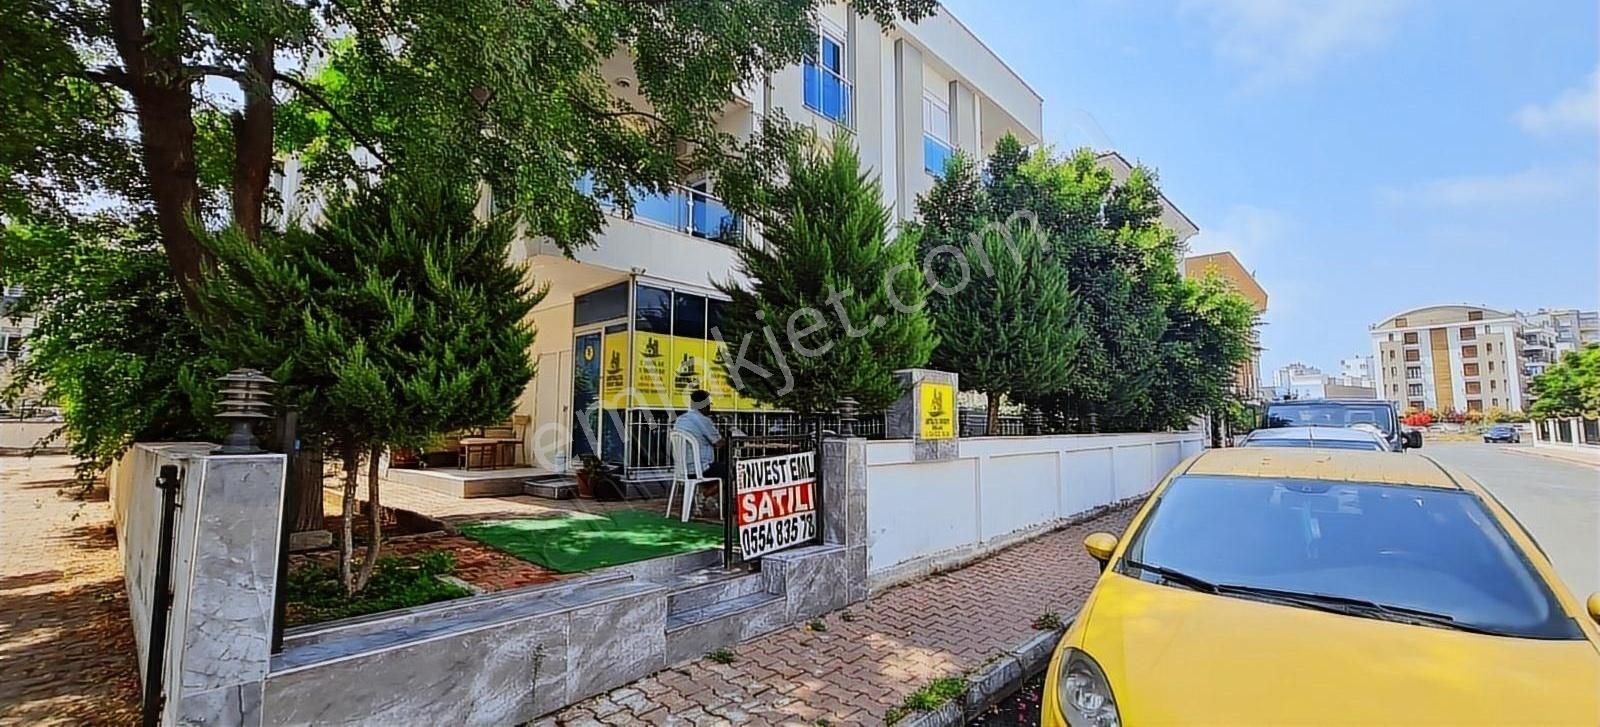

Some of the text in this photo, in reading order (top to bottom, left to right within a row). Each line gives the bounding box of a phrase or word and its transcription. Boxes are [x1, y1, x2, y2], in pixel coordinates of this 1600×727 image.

[742, 485, 815, 523] SATILI
[742, 514, 815, 556] 0554 835 78
